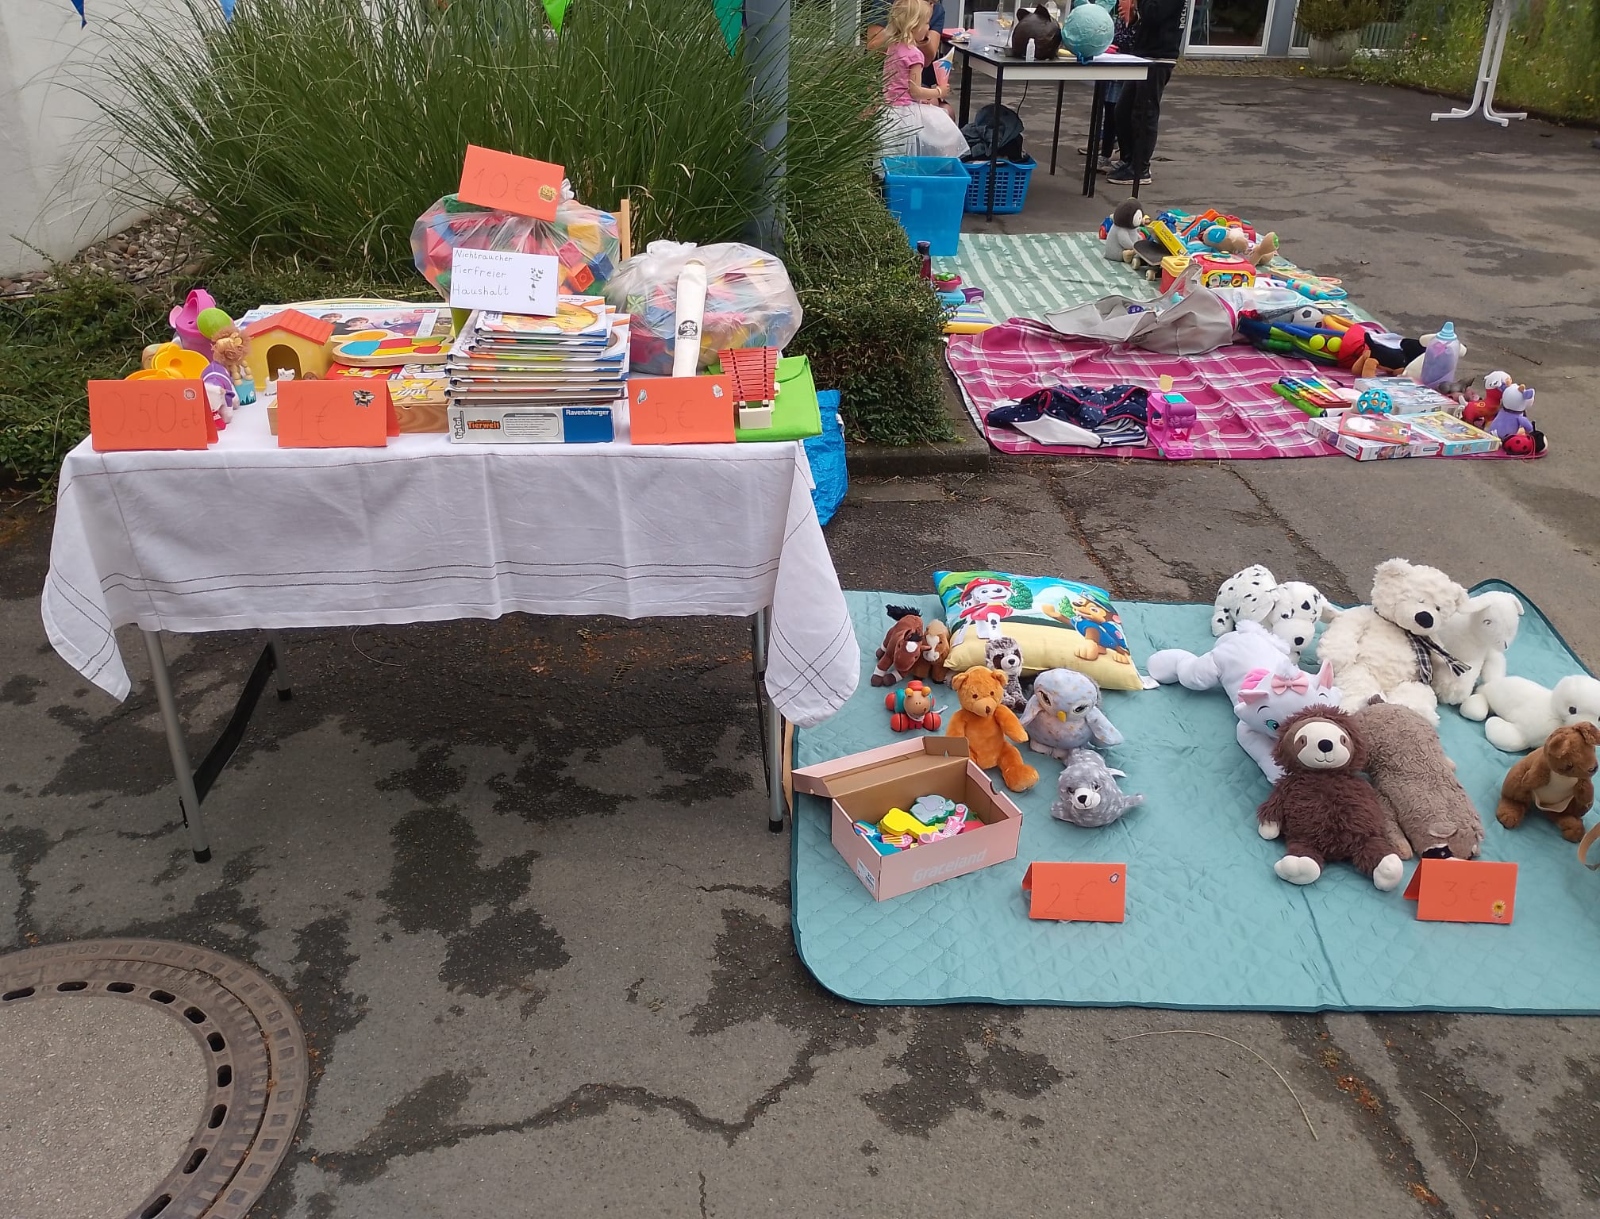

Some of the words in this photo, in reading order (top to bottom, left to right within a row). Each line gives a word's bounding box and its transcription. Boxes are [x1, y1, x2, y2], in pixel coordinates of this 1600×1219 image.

[453, 249, 513, 262] Nichtraucher
[452, 265, 507, 278] Tierfreier
[451, 282, 510, 296] Haushalt
[565, 408, 610, 417] Ravensburger
[467, 420, 501, 429] Tierwelt
[912, 847, 988, 883] Graceland
